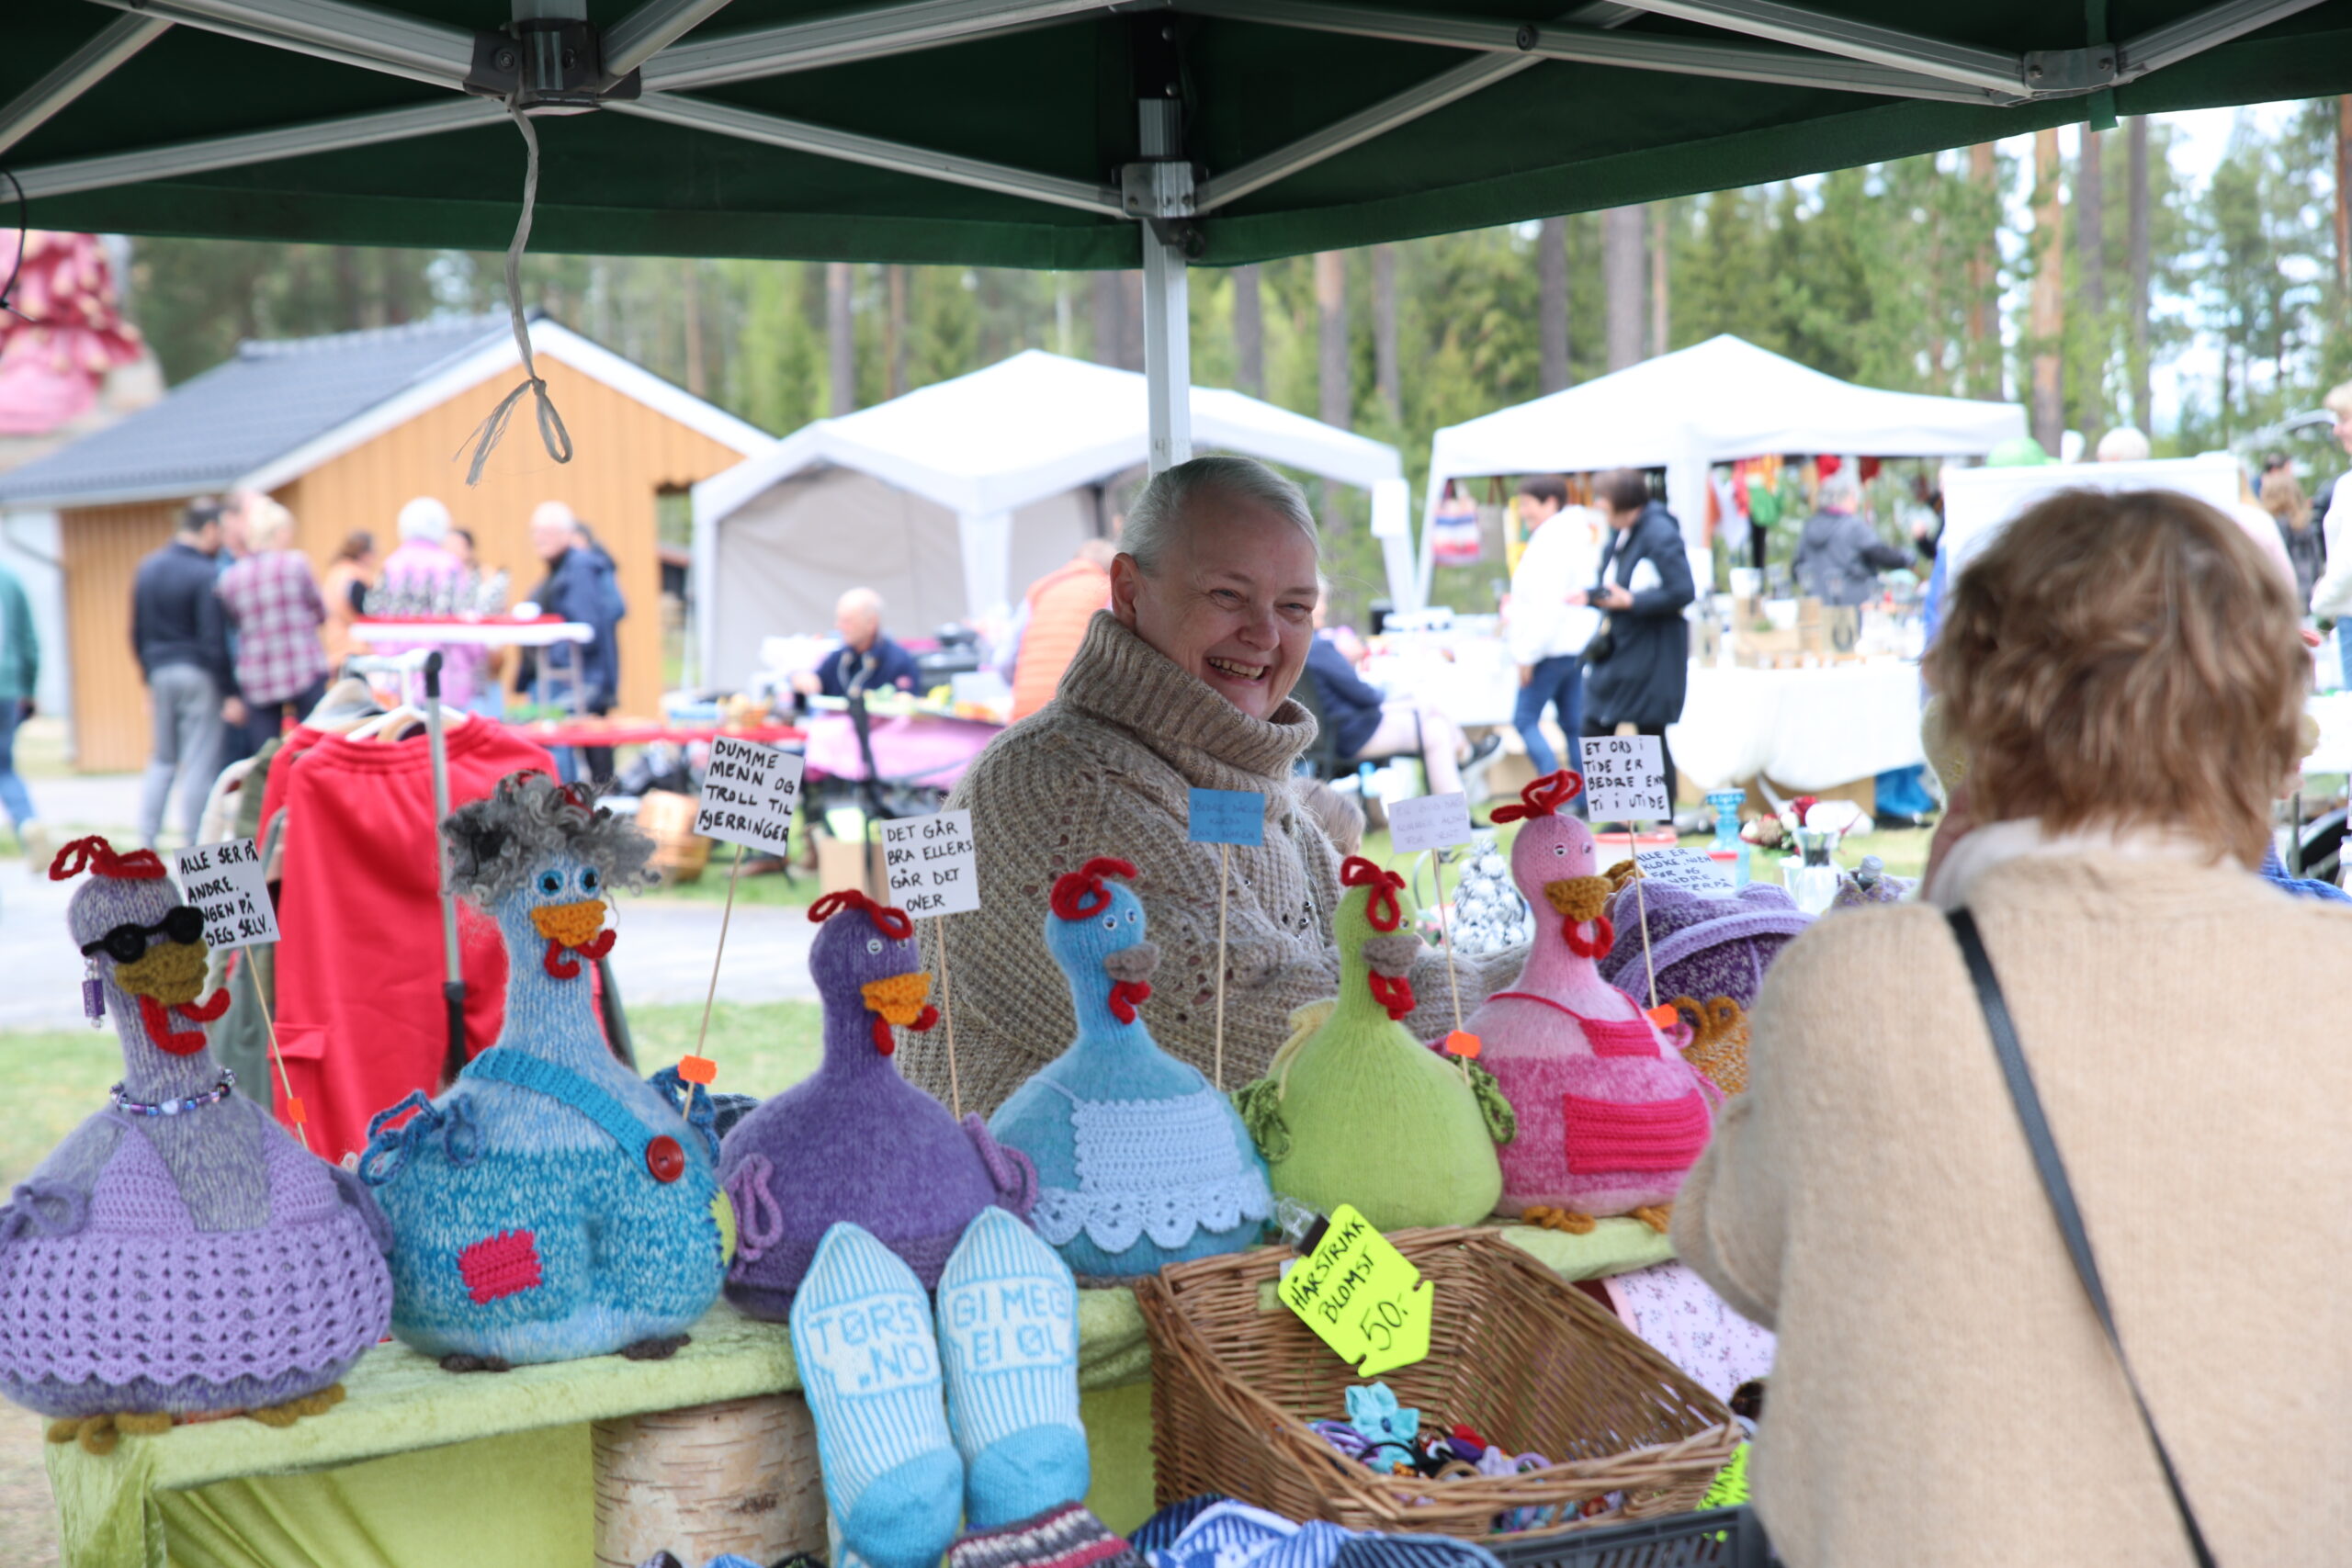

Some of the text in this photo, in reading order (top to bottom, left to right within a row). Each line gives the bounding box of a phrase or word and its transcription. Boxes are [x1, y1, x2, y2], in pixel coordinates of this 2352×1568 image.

[715, 740, 779, 769] DUMME
[1585, 742, 1600, 755] ET
[1610, 740, 1632, 753] ORD
[709, 761, 795, 795] MENN OG
[1588, 776, 1634, 791] BEDRE
[705, 784, 793, 816] TROLL TIL
[698, 808, 789, 842] KJERRINGER
[887, 818, 958, 842] DET GÅR
[180, 840, 258, 874] ALLE SER PÅ
[888, 840, 973, 866] BRA ELLERS
[1668, 848, 1688, 857] ER
[187, 876, 240, 903] ANDRE.
[890, 867, 960, 889] GÅR DET
[239, 891, 254, 915] PÅ
[906, 893, 945, 912] OVER
[206, 913, 272, 947] SEG SELV.
[1290, 1215, 1365, 1312] HÅRSTRIKK
[1318, 1244, 1374, 1325] BLOMST
[953, 1286, 1069, 1328] GI MEG
[808, 1300, 918, 1355] TØRS
[973, 1325, 1065, 1367] EI ØL
